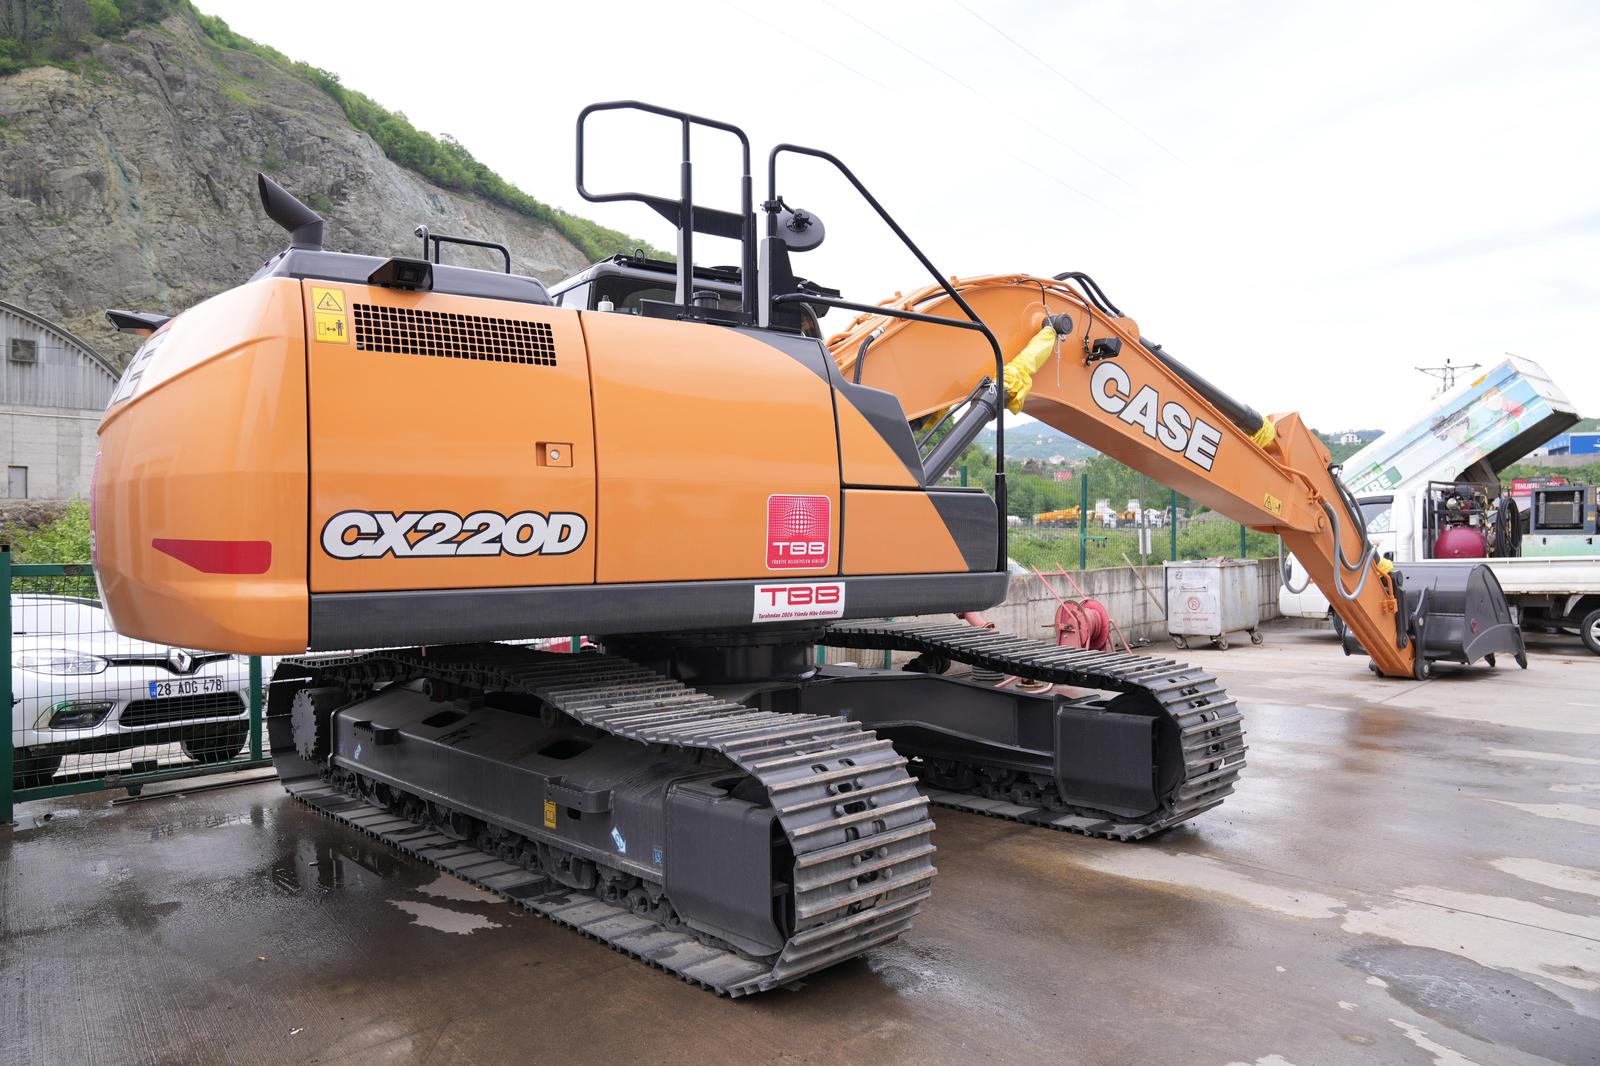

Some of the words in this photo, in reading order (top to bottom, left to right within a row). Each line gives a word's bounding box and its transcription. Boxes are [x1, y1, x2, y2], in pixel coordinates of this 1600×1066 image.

[1090, 361, 1223, 472] CASE
[321, 510, 588, 560] CX220D
[773, 541, 825, 555] TBB
[760, 585, 840, 606] TBB
[157, 683, 172, 696] 28
[178, 681, 198, 694] ADG
[203, 678, 222, 692] 478
